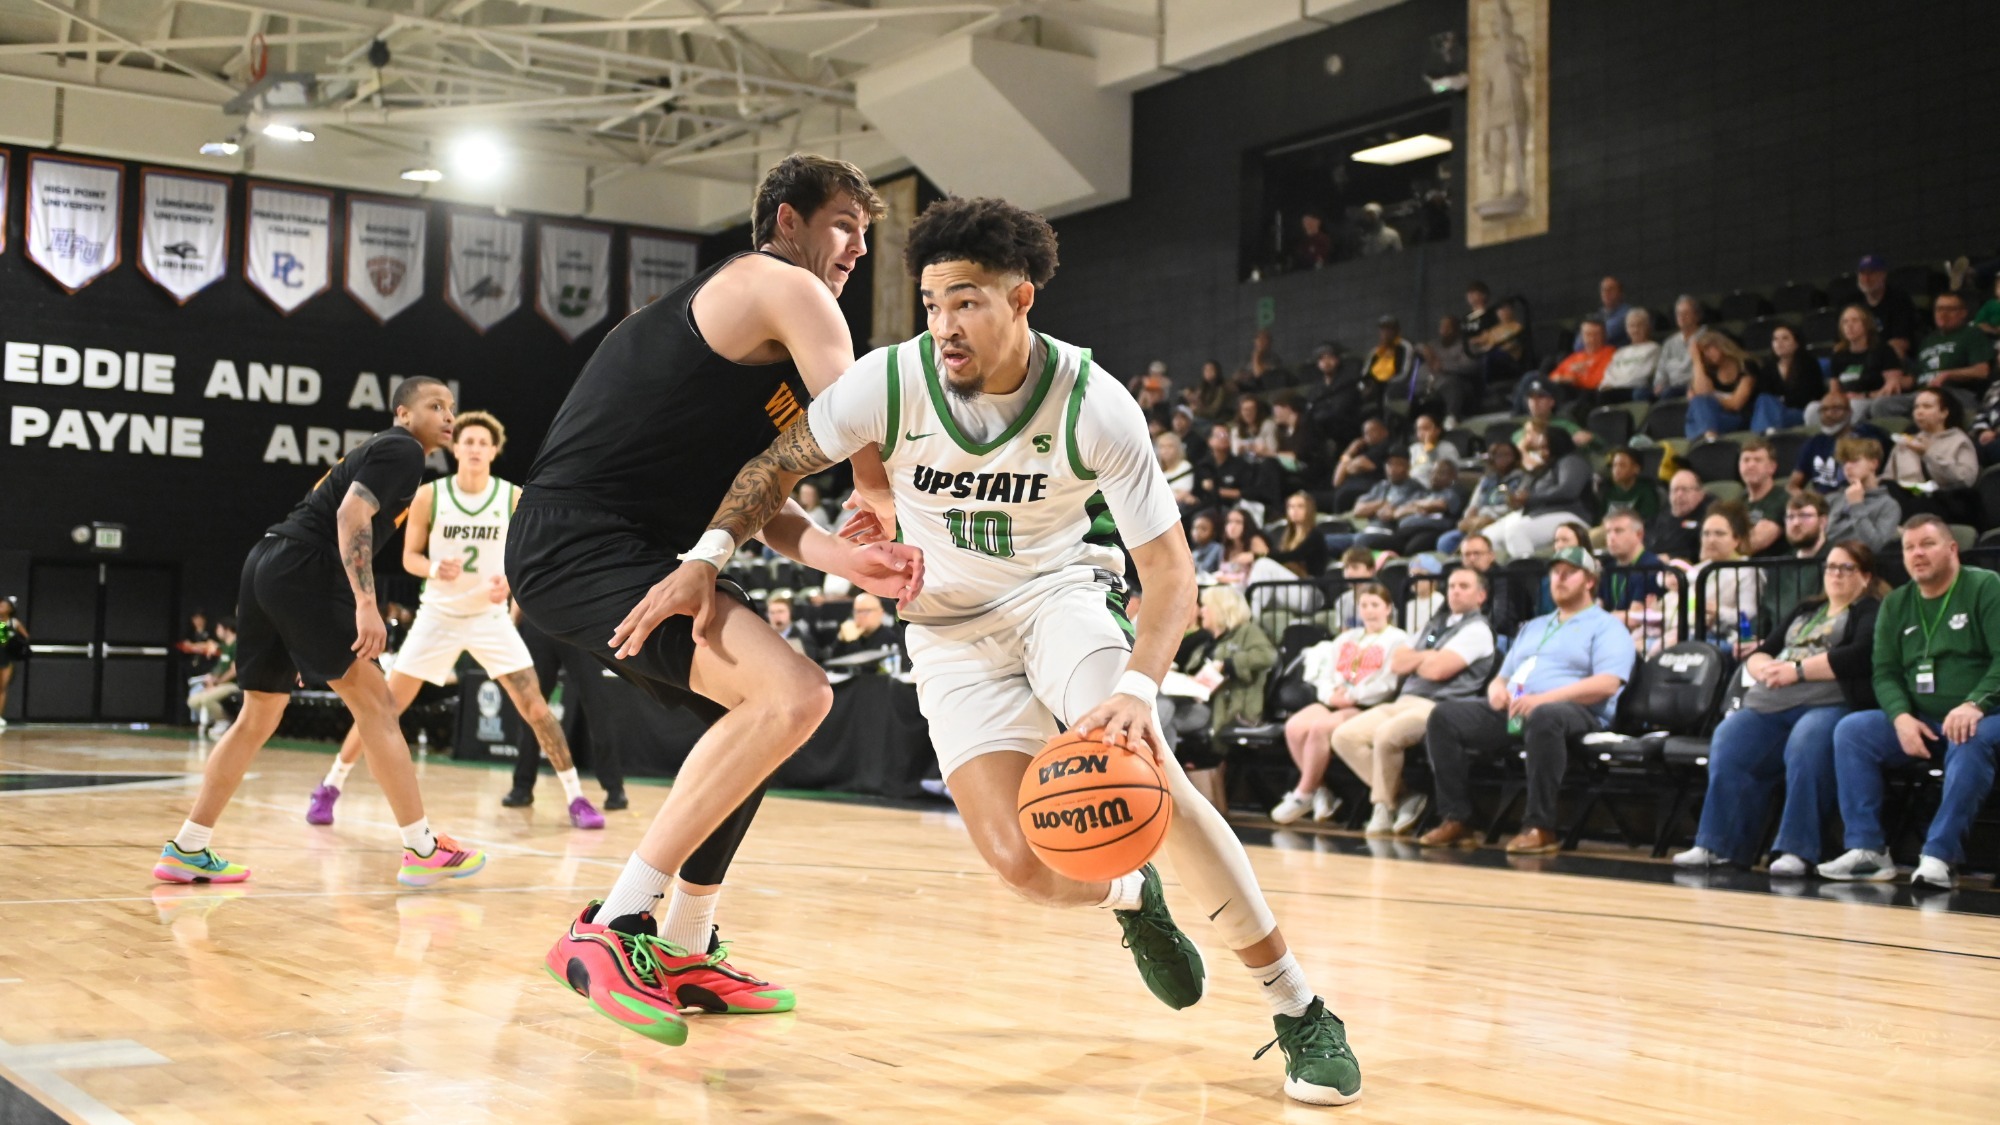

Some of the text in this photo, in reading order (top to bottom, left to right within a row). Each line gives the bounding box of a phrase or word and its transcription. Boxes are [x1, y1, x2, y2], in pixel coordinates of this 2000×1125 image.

[42, 198, 106, 212] UNIVERSITY
[271, 251, 305, 288] PC
[4, 341, 176, 395] EDDIE
[204, 359, 322, 405] AND
[10, 405, 204, 458] PAYNE
[913, 464, 1049, 504] UPSTATE
[443, 525, 501, 540] UPSTATE
[942, 507, 1016, 559] 10
[462, 545, 480, 573] 2
[1038, 754, 1109, 786] NCAA
[1031, 797, 1134, 834] Wilson
